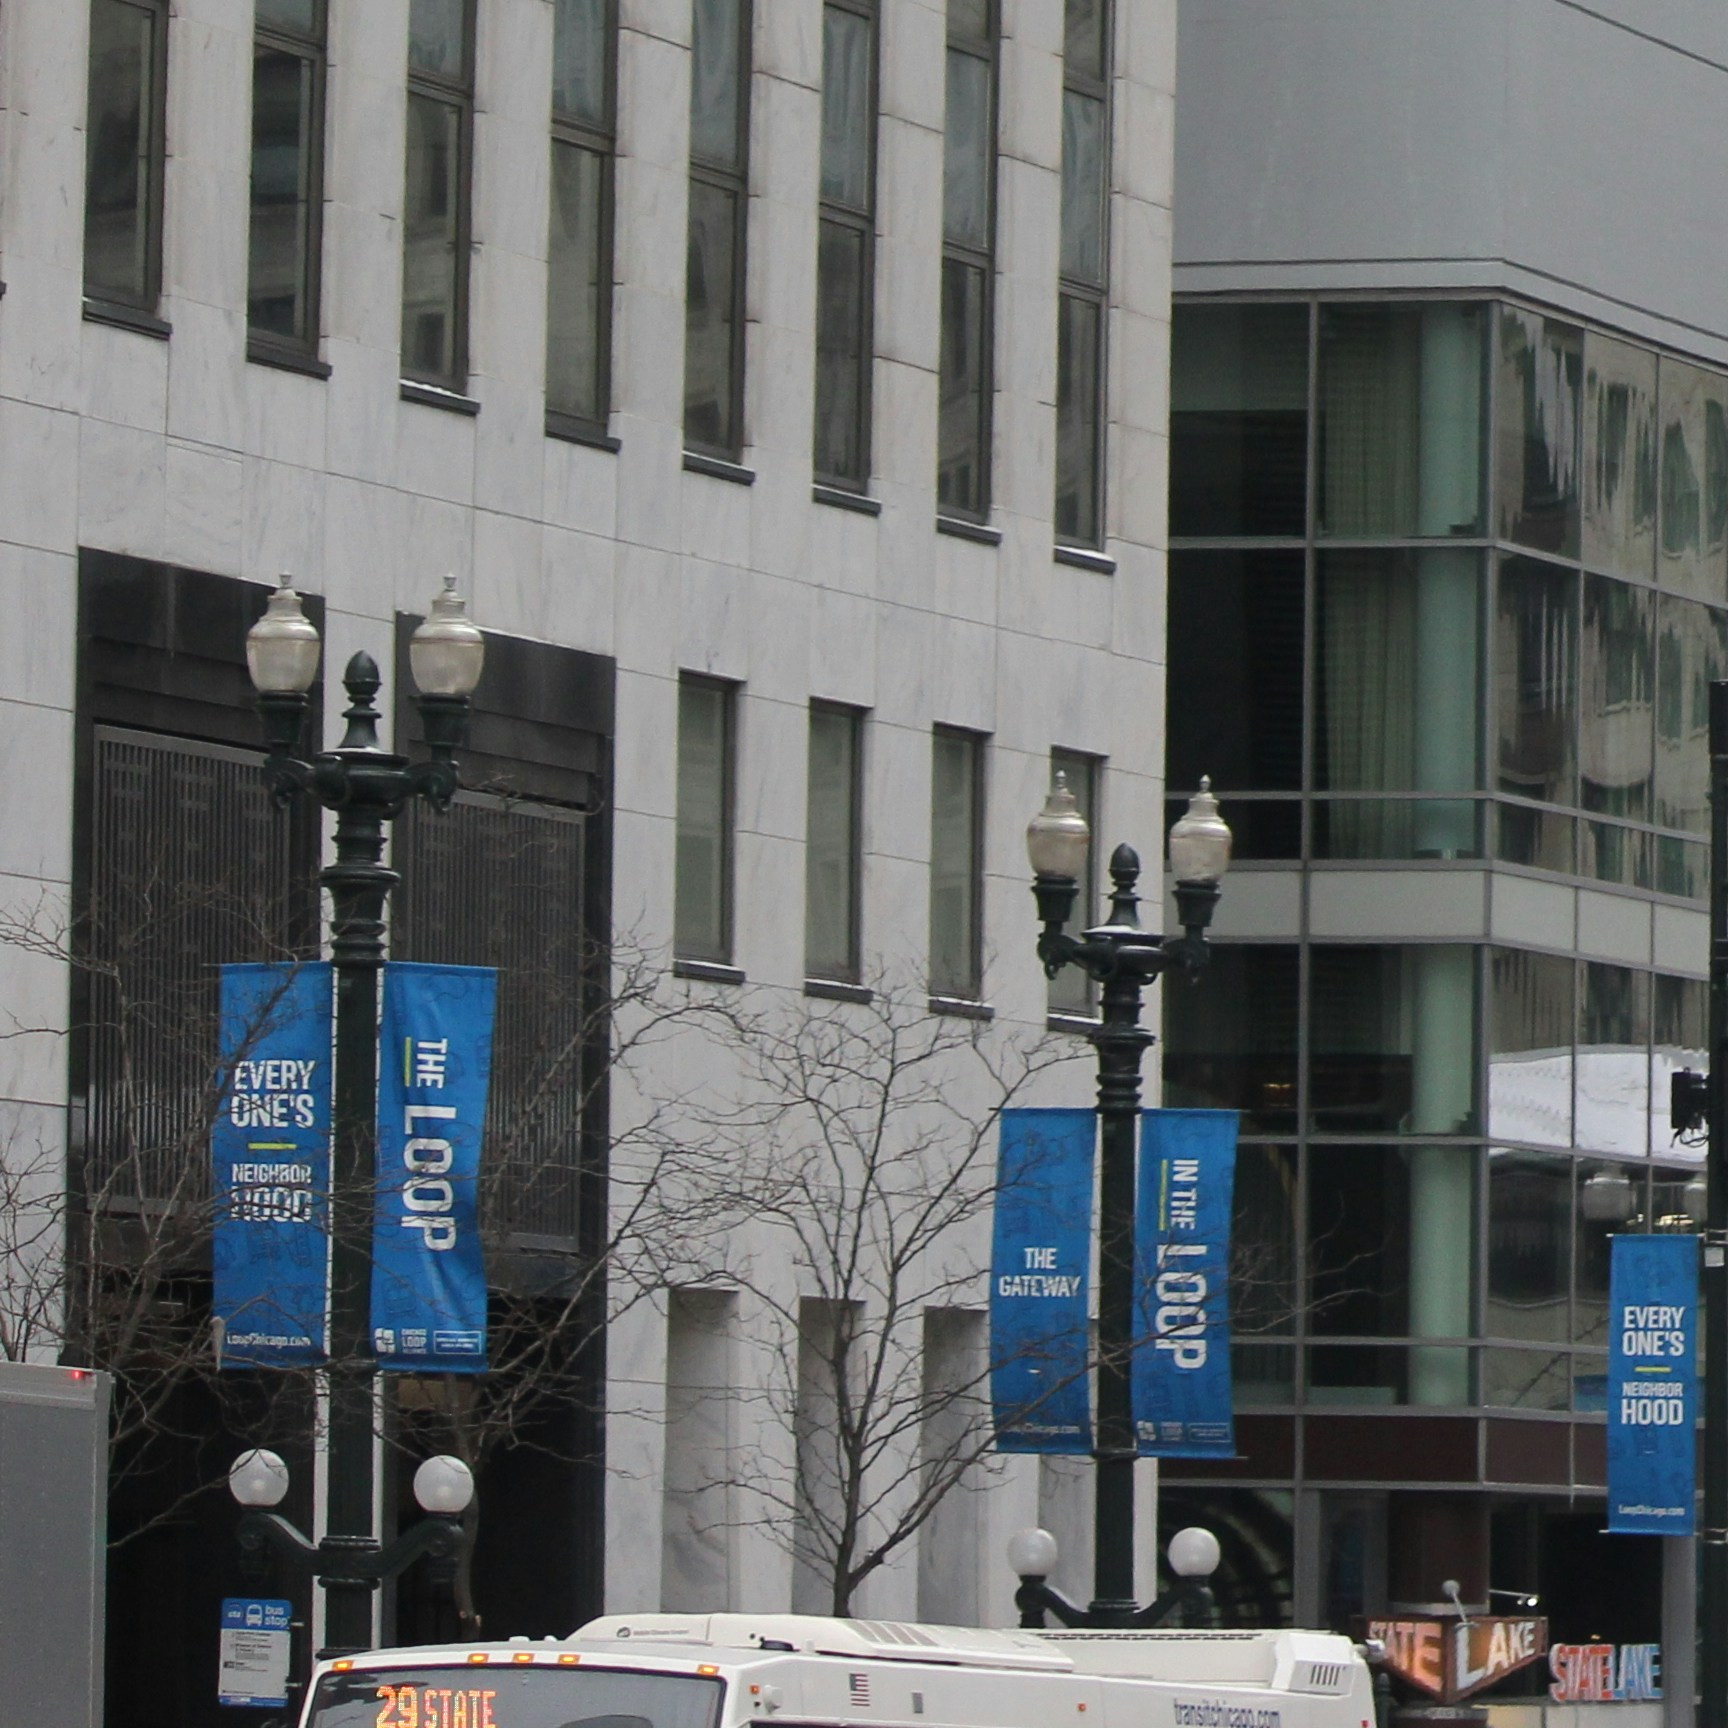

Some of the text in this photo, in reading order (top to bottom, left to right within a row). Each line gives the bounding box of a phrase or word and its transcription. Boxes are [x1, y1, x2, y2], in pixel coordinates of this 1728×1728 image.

[234, 1059, 315, 1091] EVERY
[231, 1094, 315, 1129] ONE'S
[401, 1038, 456, 1251] THE LOOP
[231, 1163, 312, 1185] NEIGHBOR
[231, 1187, 312, 1223] HOOD
[1024, 1248, 1057, 1270] THE
[1155, 1160, 1208, 1370] IN THE LOOP
[999, 1275, 1080, 1298] GATEWAY
[1624, 1306, 1685, 1329] EVERY
[402, 1336, 426, 1347] LOOP
[1622, 1331, 1684, 1356] ONE'S
[1622, 1381, 1683, 1397] NEIGHBOR
[1621, 1399, 1684, 1426] HOOD
[265, 1605, 284, 1615] bus
[265, 1616, 287, 1627] stop
[1369, 1620, 1536, 1693] STATE LAKE
[1549, 1643, 1663, 1702] STATE LAKE
[376, 1686, 497, 1728] 29 STATE
